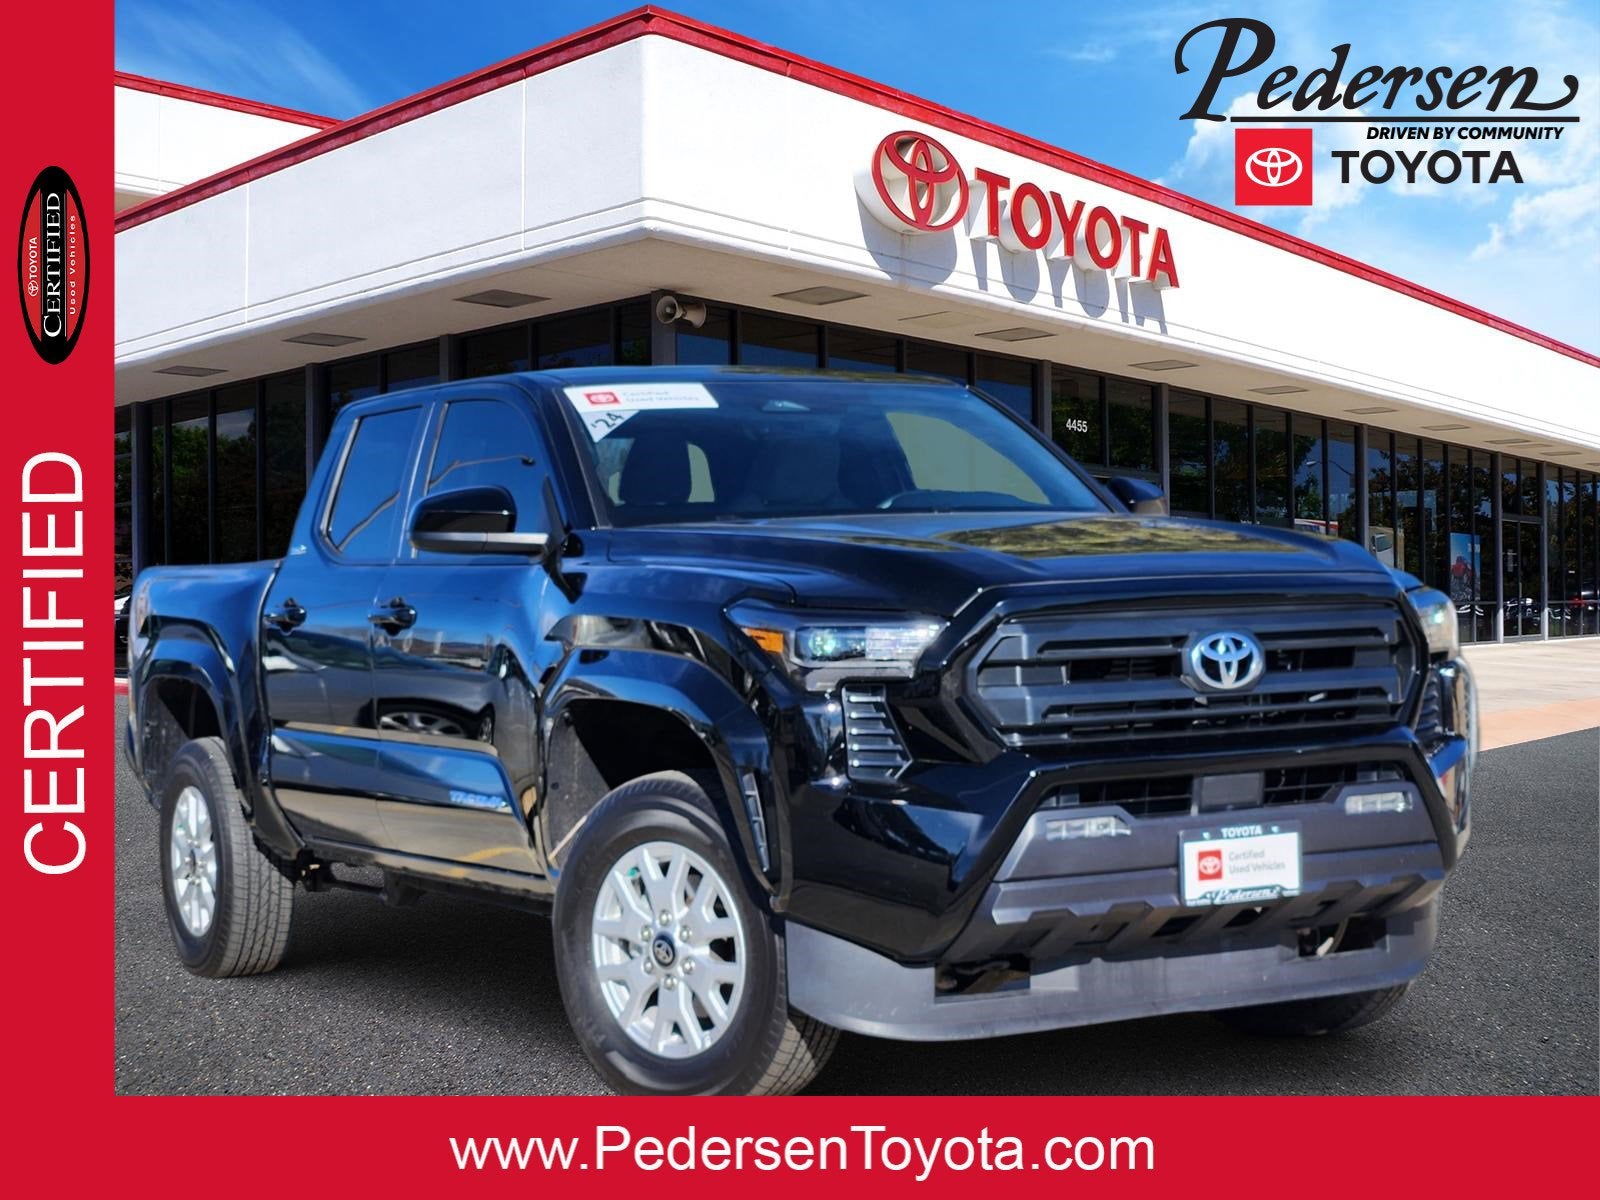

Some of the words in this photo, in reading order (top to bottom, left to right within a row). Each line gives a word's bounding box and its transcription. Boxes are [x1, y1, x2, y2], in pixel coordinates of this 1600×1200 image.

[975, 167, 1180, 289] TOYOTA
[1065, 418, 1088, 433] 4455
[1221, 825, 1263, 839] TOYOTA
[1228, 849, 1265, 861] Certified
[1229, 863, 1250, 875] Used
[1251, 861, 1286, 872] Vehicles
